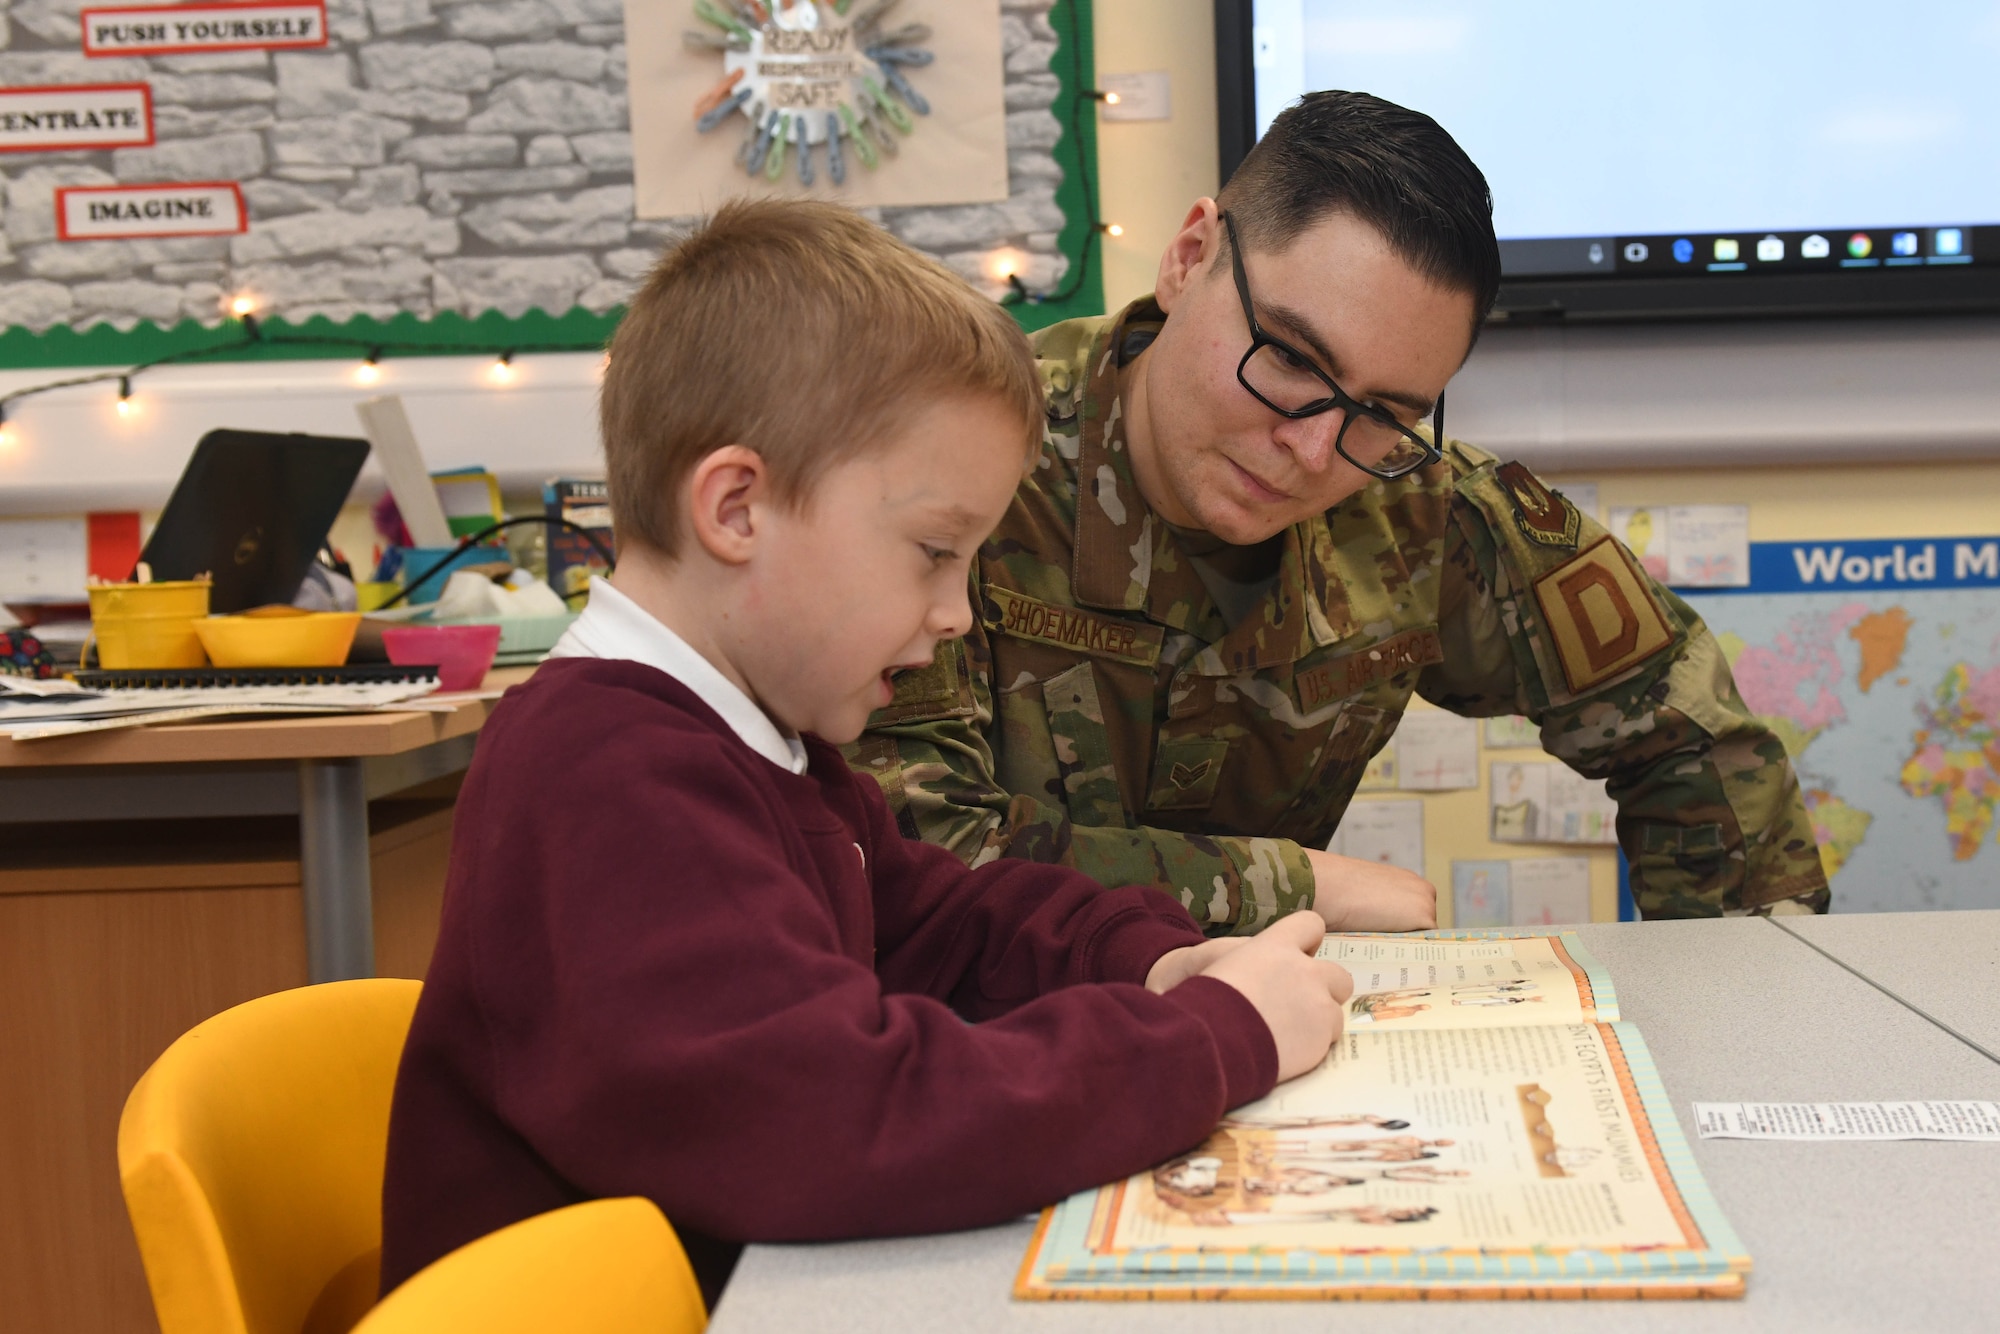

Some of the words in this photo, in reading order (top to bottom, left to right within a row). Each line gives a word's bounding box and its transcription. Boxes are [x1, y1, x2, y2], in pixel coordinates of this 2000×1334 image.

[96, 23, 165, 43] PUSH
[174, 18, 314, 40] YOURSELF
[776, 81, 842, 107] SAFE
[0, 108, 138, 132] ENTRATE
[88, 197, 214, 222] IMAGINE
[1793, 544, 1936, 583] World
[1953, 543, 2000, 579] M
[1006, 598, 1136, 656] SHOEMAKER
[1557, 561, 1639, 673] D
[1347, 658, 1374, 691] AIR
[1380, 633, 1437, 680] FORCE
